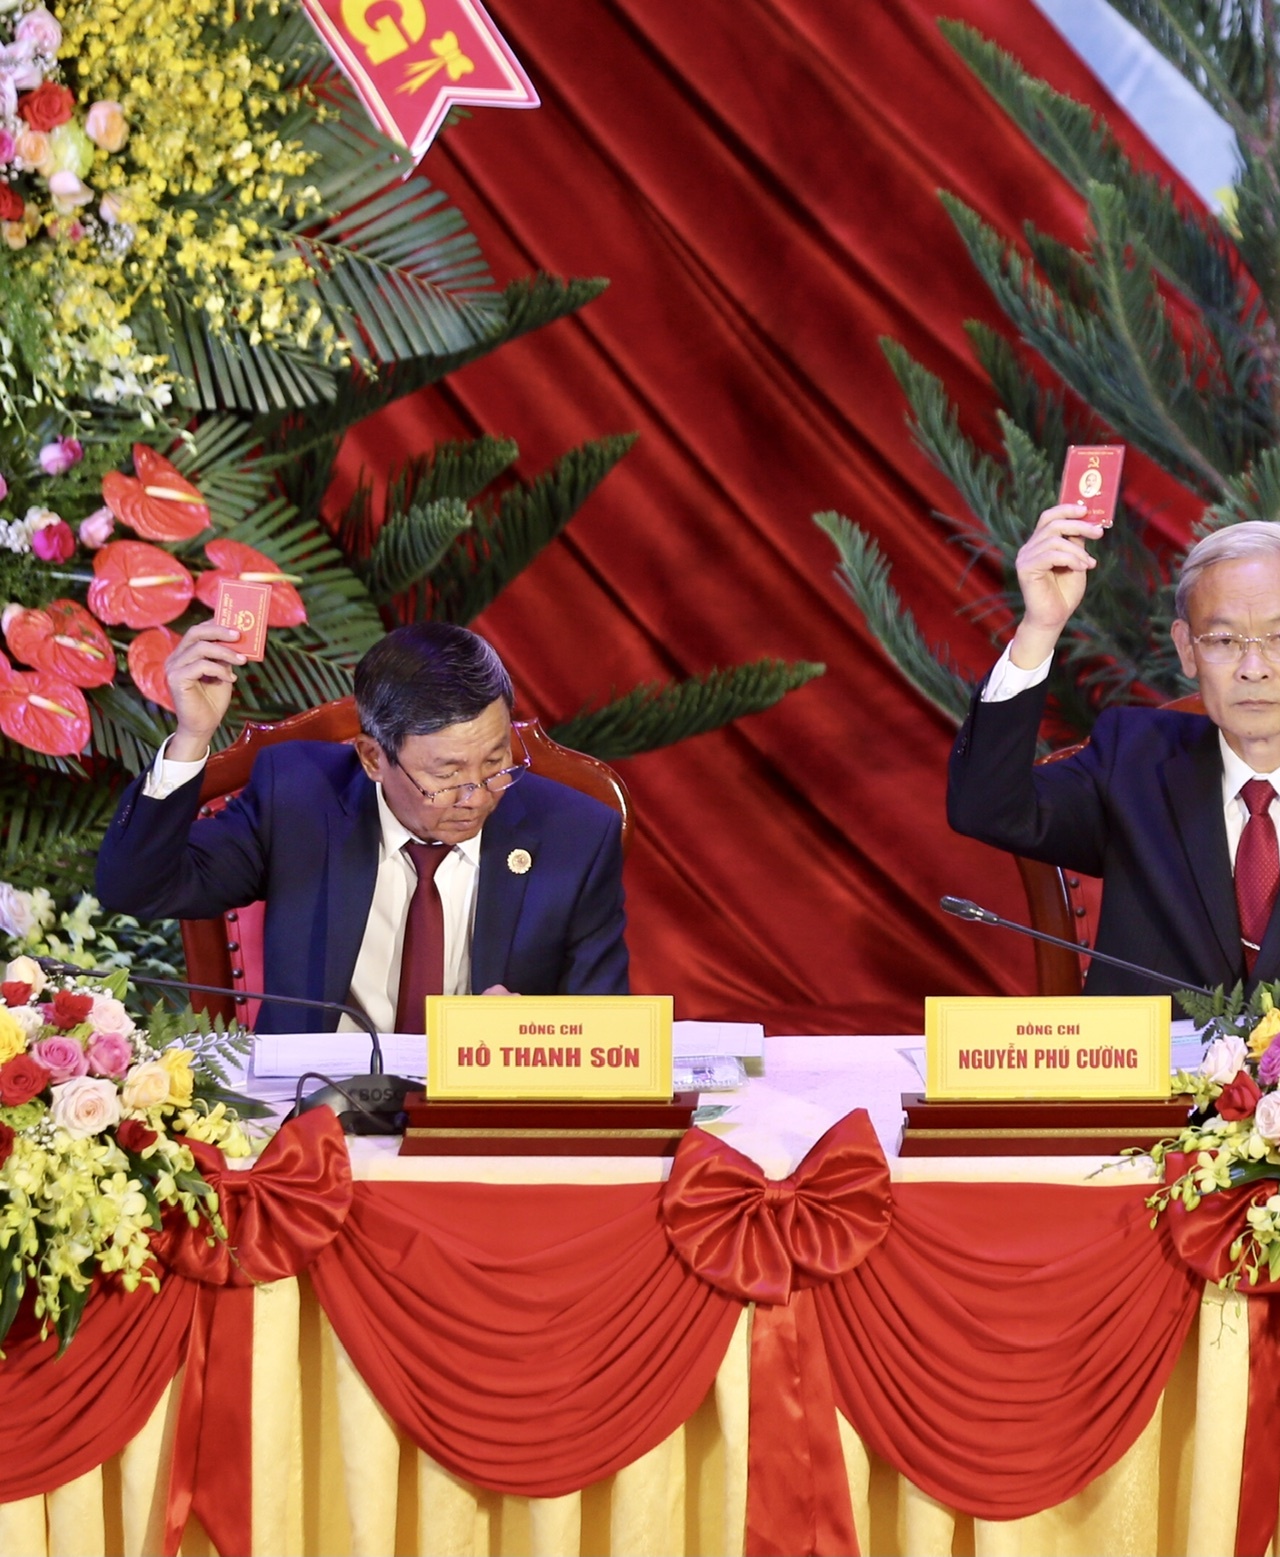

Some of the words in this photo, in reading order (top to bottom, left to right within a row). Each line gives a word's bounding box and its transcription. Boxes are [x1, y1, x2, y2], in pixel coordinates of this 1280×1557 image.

[560, 1024, 583, 1035] CHÍ
[1057, 1024, 1080, 1035] CHÍ
[458, 1040, 491, 1067] HỒ
[499, 1047, 581, 1068] THANH
[590, 1045, 639, 1068] SƠN
[959, 1043, 1027, 1070] NGUYỄN
[1034, 1046, 1070, 1069] PHÚ
[1076, 1045, 1138, 1069] CƯỜNG
